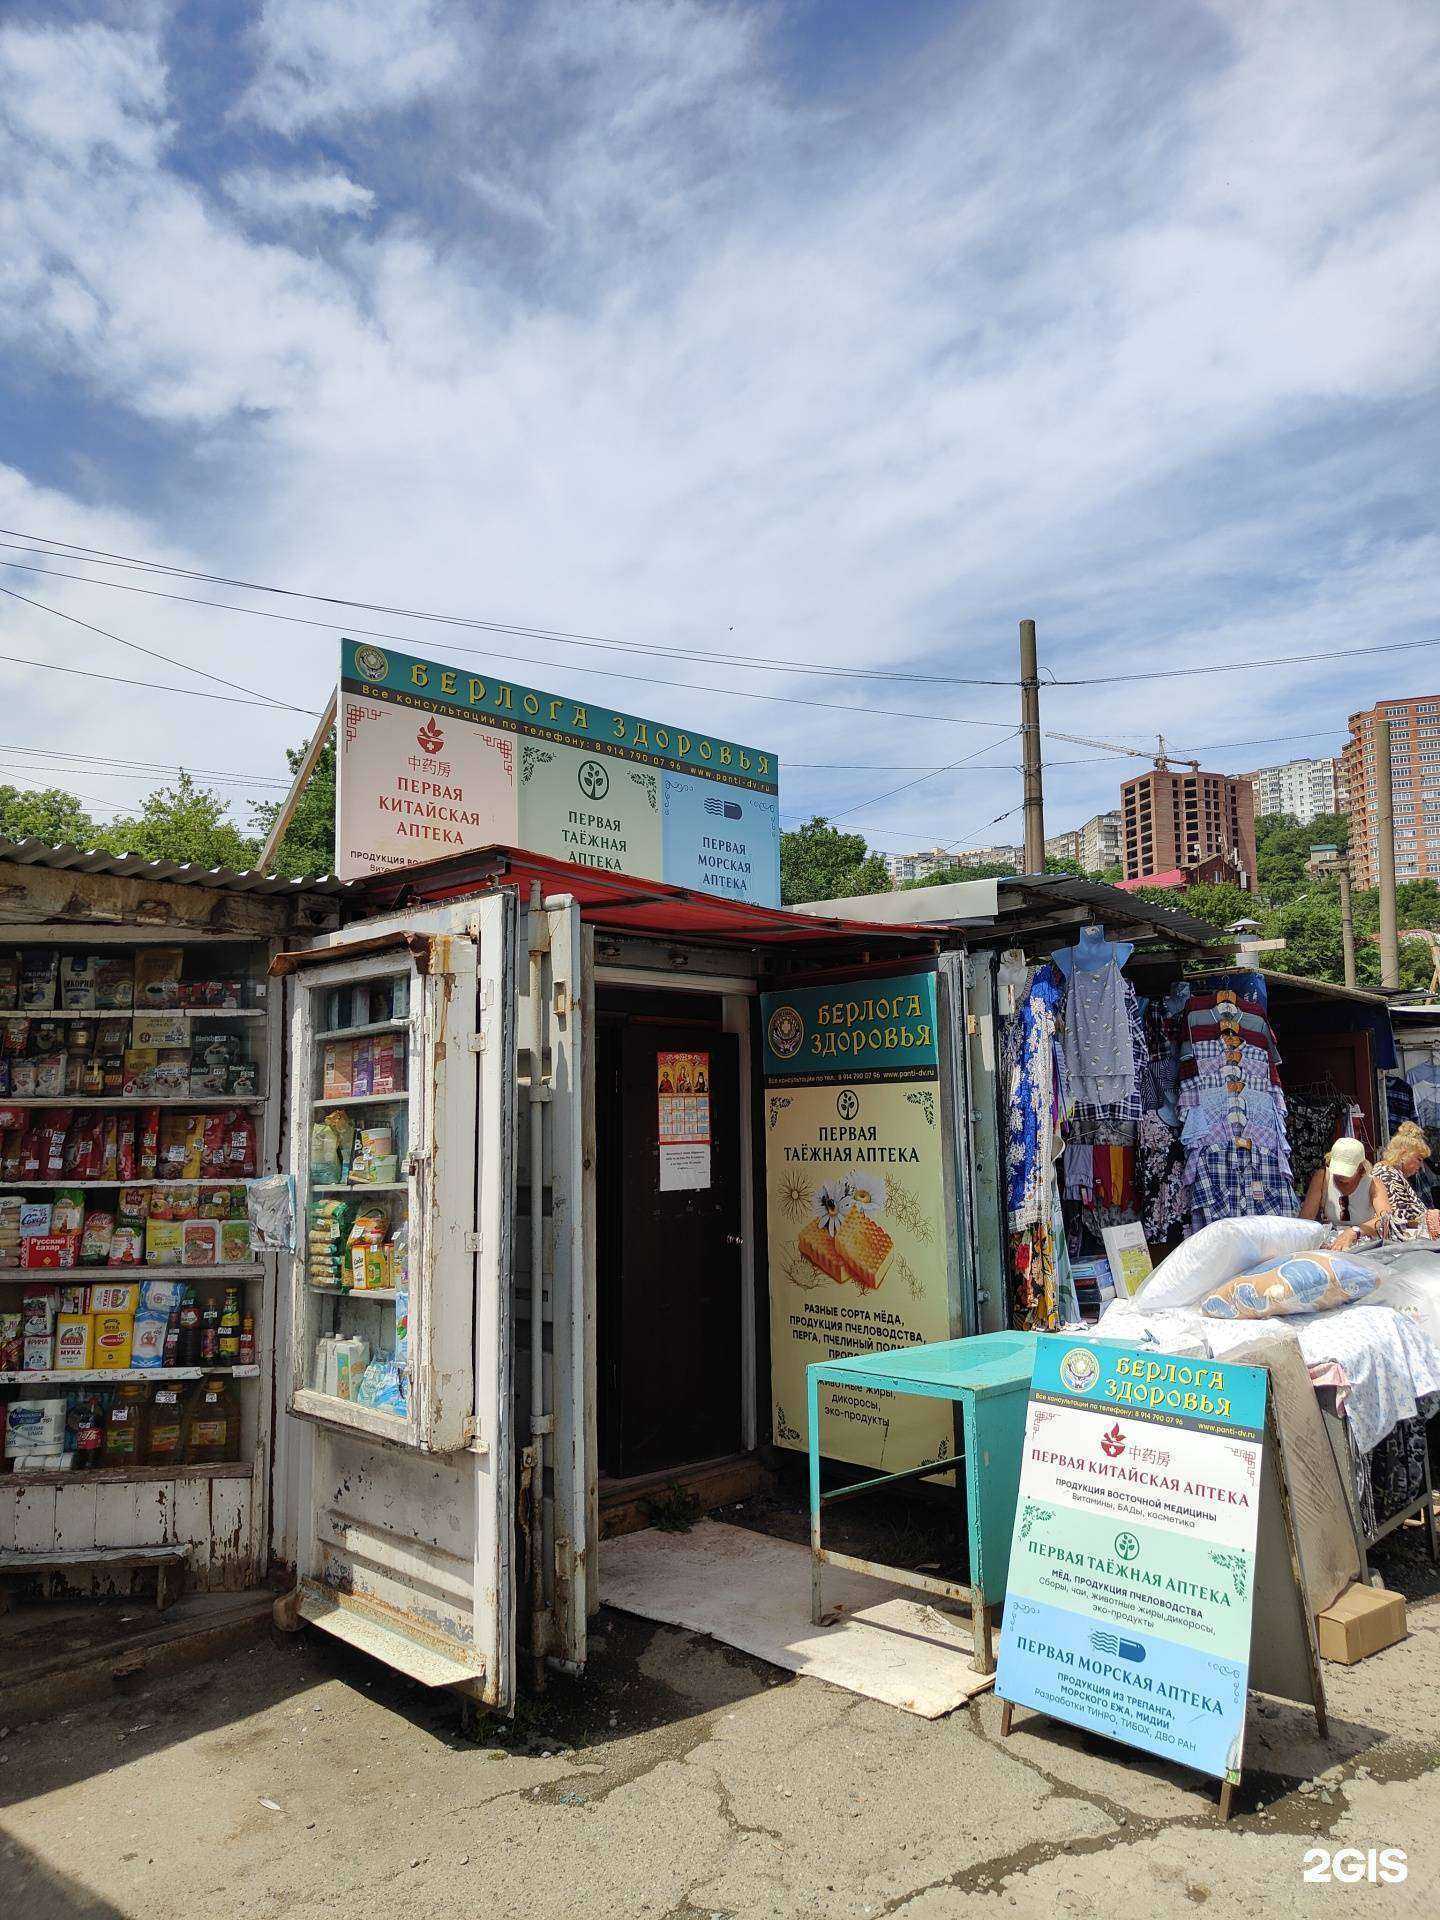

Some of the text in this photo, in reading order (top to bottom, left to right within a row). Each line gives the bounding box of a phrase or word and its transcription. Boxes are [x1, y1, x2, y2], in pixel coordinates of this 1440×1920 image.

[362, 684, 389, 699] Все
[396, 693, 496, 725] консультации
[502, 719, 517, 730] по
[523, 725, 591, 749] телефону:
[595, 742, 601, 752] 8
[607, 745, 625, 757] 914
[630, 750, 649, 762] 790
[653, 757, 664, 766] 07
[670, 760, 681, 769] 96
[411, 664, 769, 775] БЕРЛОГА ЗДОРОВЬЯ
[408, 756, 451, 777] 中药房
[398, 777, 463, 802] ПЕРВАЯ
[379, 796, 481, 826] КИТАЙСКАЯ
[569, 811, 622, 832] ПЕРВАЯ
[397, 821, 464, 845] АПТЕКА
[561, 828, 627, 852] ТАЁЖНАЯ
[350, 850, 405, 865] ПРОДУКЦИЯ
[703, 836, 746, 855] ПЕРВАЯ
[569, 850, 622, 871] АПТЕКА
[698, 854, 751, 874] МОРСКАЯ
[702, 873, 747, 891] АПТЕКА
[817, 994, 922, 1027] БЕРЛОГА
[811, 1024, 932, 1057] ЗДОРОВЬЯ
[819, 1126, 877, 1142] ПЕРВАЯ
[784, 1143, 920, 1163] ТАЁЖНАЯ АПТЕКА
[31, 1237, 66, 1246] Русский
[35, 1243, 60, 1252] сахар
[804, 1303, 905, 1327] РАЗНЫЕ СОРТА МЁДА,
[790, 1315, 927, 1344] ПРОДУКЦИЯ ПЧЕЛОВОДСТВА,
[792, 1329, 821, 1344] ПЕРГА,
[823, 1334, 874, 1350] ПЧЕЛИНЫЙ
[1116, 1357, 1224, 1391] БЕРЛОГА
[831, 1394, 881, 1412] дикоросы,
[865, 1385, 896, 1400] жиры,
[1104, 1378, 1231, 1418] ЗДОРОВЬЯ
[825, 1406, 890, 1428] эко-продукты
[1035, 1392, 1047, 1400] Все
[1048, 1395, 1089, 1409] консультации
[1099, 1404, 1135, 1417] телефону:
[1140, 1411, 1151, 1420] 914
[1152, 1413, 1165, 1422] 790
[1166, 1416, 1175, 1424] 07
[1175, 1417, 1183, 1425] 96
[1128, 1445, 1171, 1468] 中药房
[1031, 1448, 1250, 1507] ПЕРВАЯ КИТАЙСКАЯ АПТЕКА
[1055, 1477, 1217, 1522] ПРОДУКЦИЯ ВОСТОЧНОЙ МЕДИЦИНЫ
[1072, 1492, 1195, 1528] Витамины, БАДы, косметика
[1028, 1541, 1231, 1608] ПЕРВАЯ ТАЁЖНАЯ АПТЕКА
[1038, 1576, 1069, 1593] Сборы,
[1091, 1591, 1137, 1612] животные
[1074, 1575, 1127, 1597] ПРОДУКЦИЯ
[1129, 1591, 1203, 1620] ПЧЕЛОВОДСТВА
[1092, 1604, 1154, 1628] эко-продукты
[1016, 1636, 1224, 1716] ПЕРВАЯ МОРСКАЯ АПТЕКА
[1057, 1672, 1176, 1721] ПРОДУКЦИЯ ИЗ ТРЕПАНГА,
[1060, 1685, 1170, 1730] МОРСКОГО ЕЖА, МИДИИ
[1087, 1706, 1119, 1726] ТИНРО,
[1120, 1717, 1152, 1738] ТИБОХ,
[1154, 1730, 1176, 1746] ДВО
[1177, 1737, 1197, 1752] РАН
